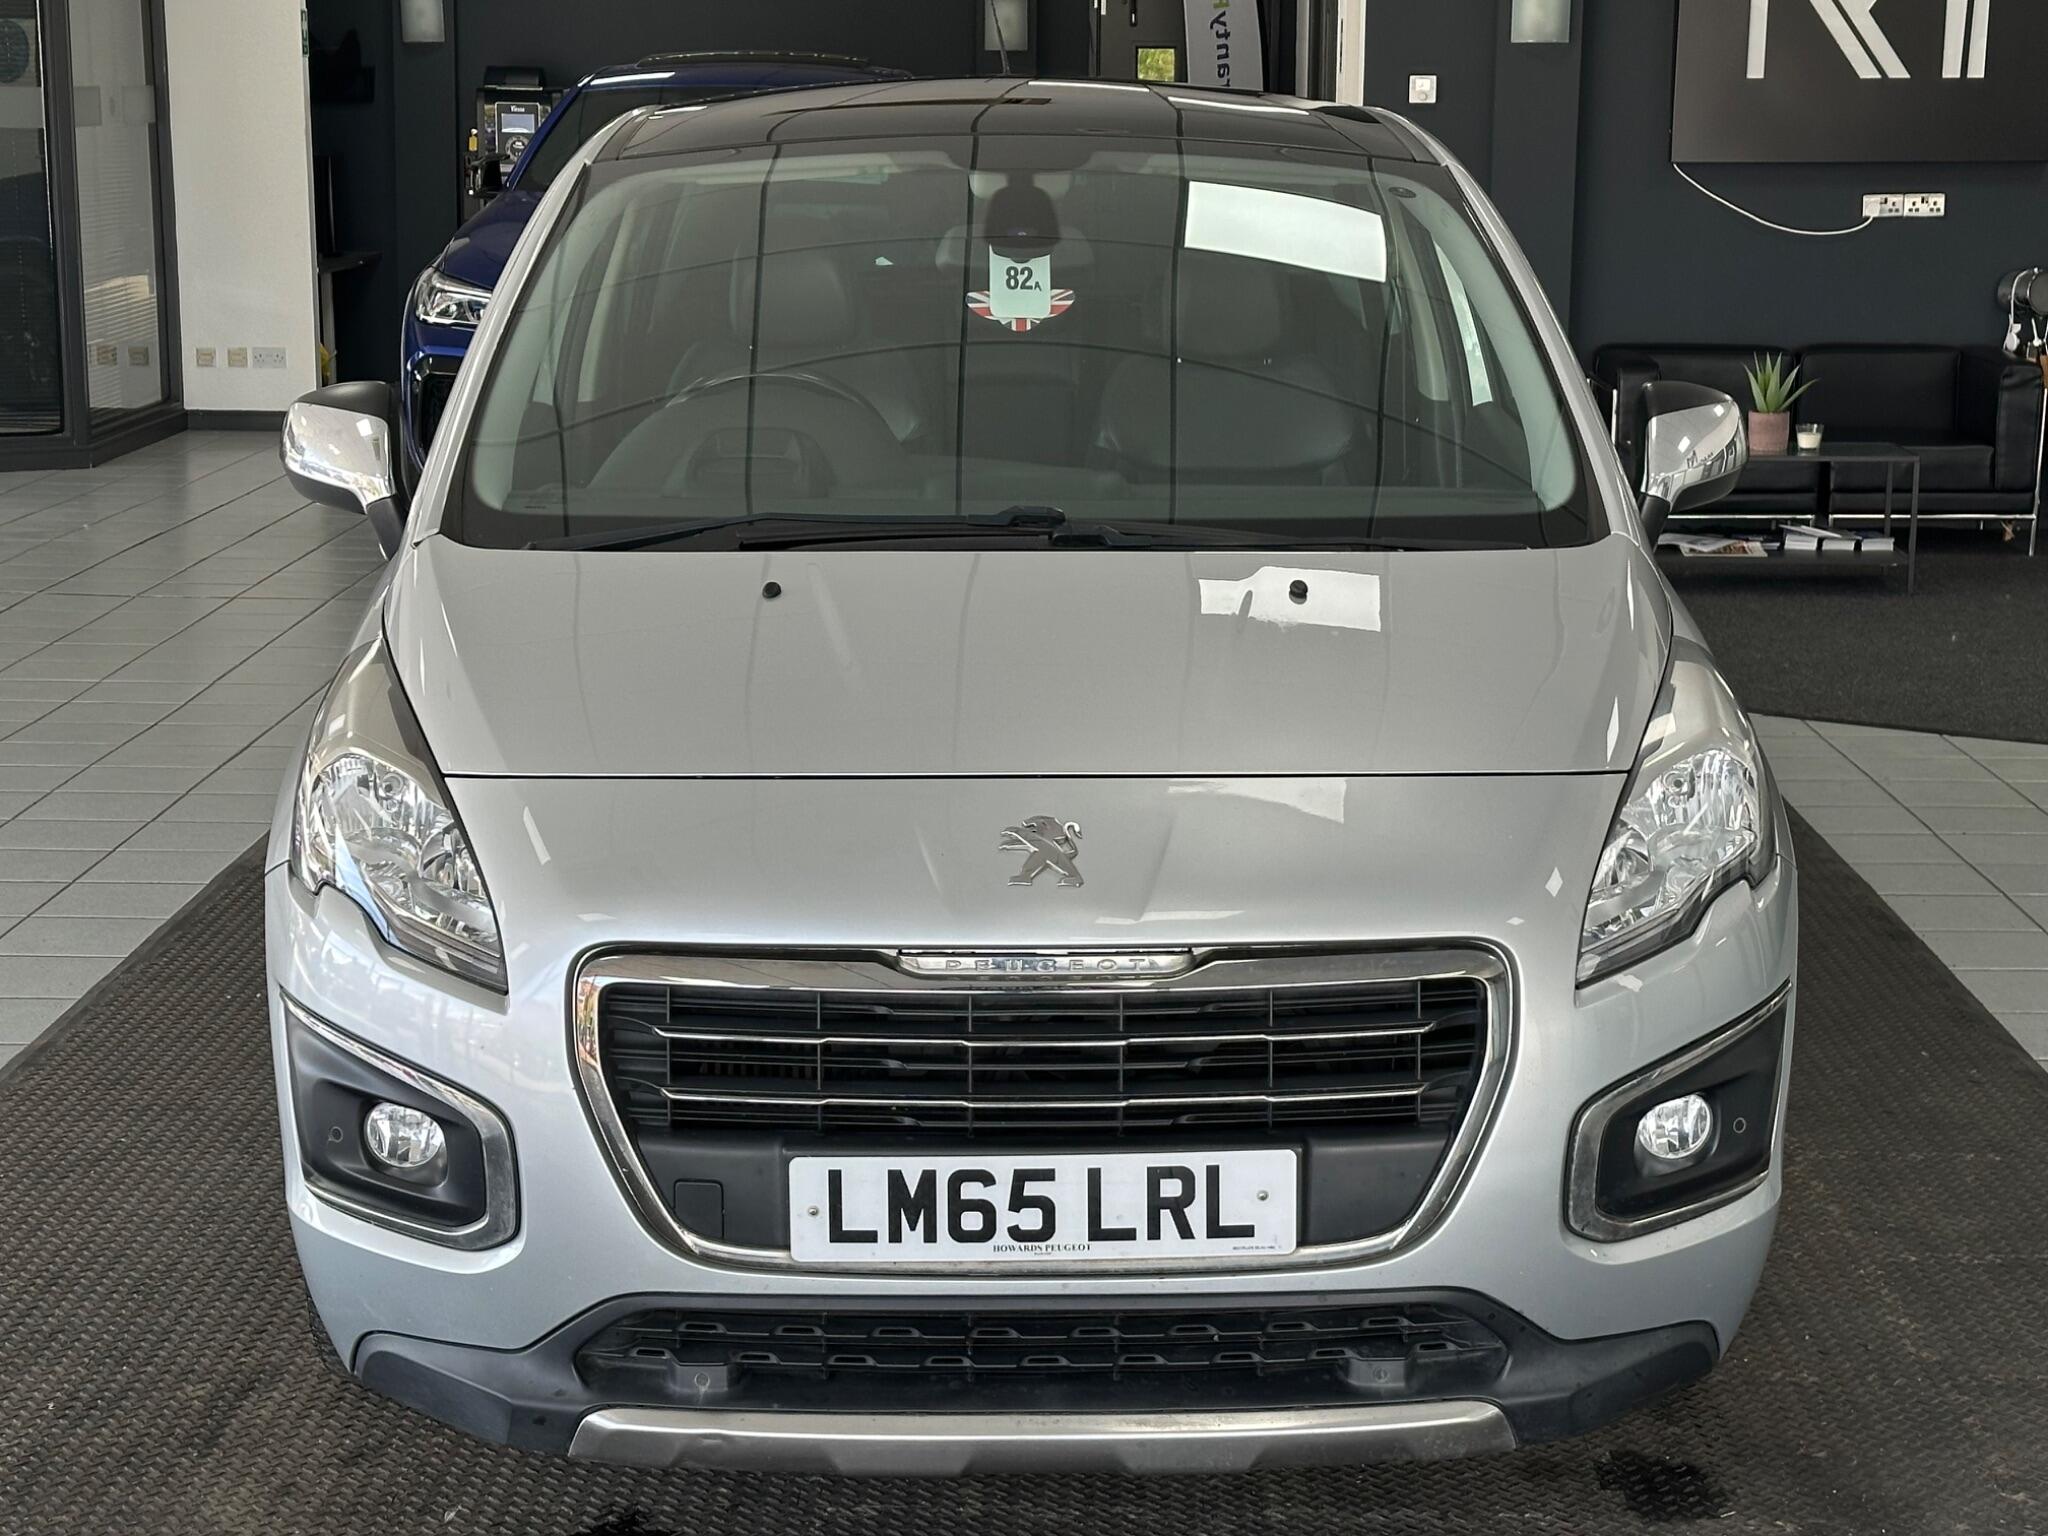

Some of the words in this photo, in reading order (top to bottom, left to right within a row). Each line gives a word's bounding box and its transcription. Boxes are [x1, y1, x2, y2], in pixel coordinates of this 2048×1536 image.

[945, 959, 1147, 972] PEUGEOT
[827, 1168, 1057, 1244] LM65
[1086, 1164, 1256, 1242] LRL
[993, 1244, 1043, 1252] HOWARDS
[1045, 1243, 1091, 1252] PEUGEOT
